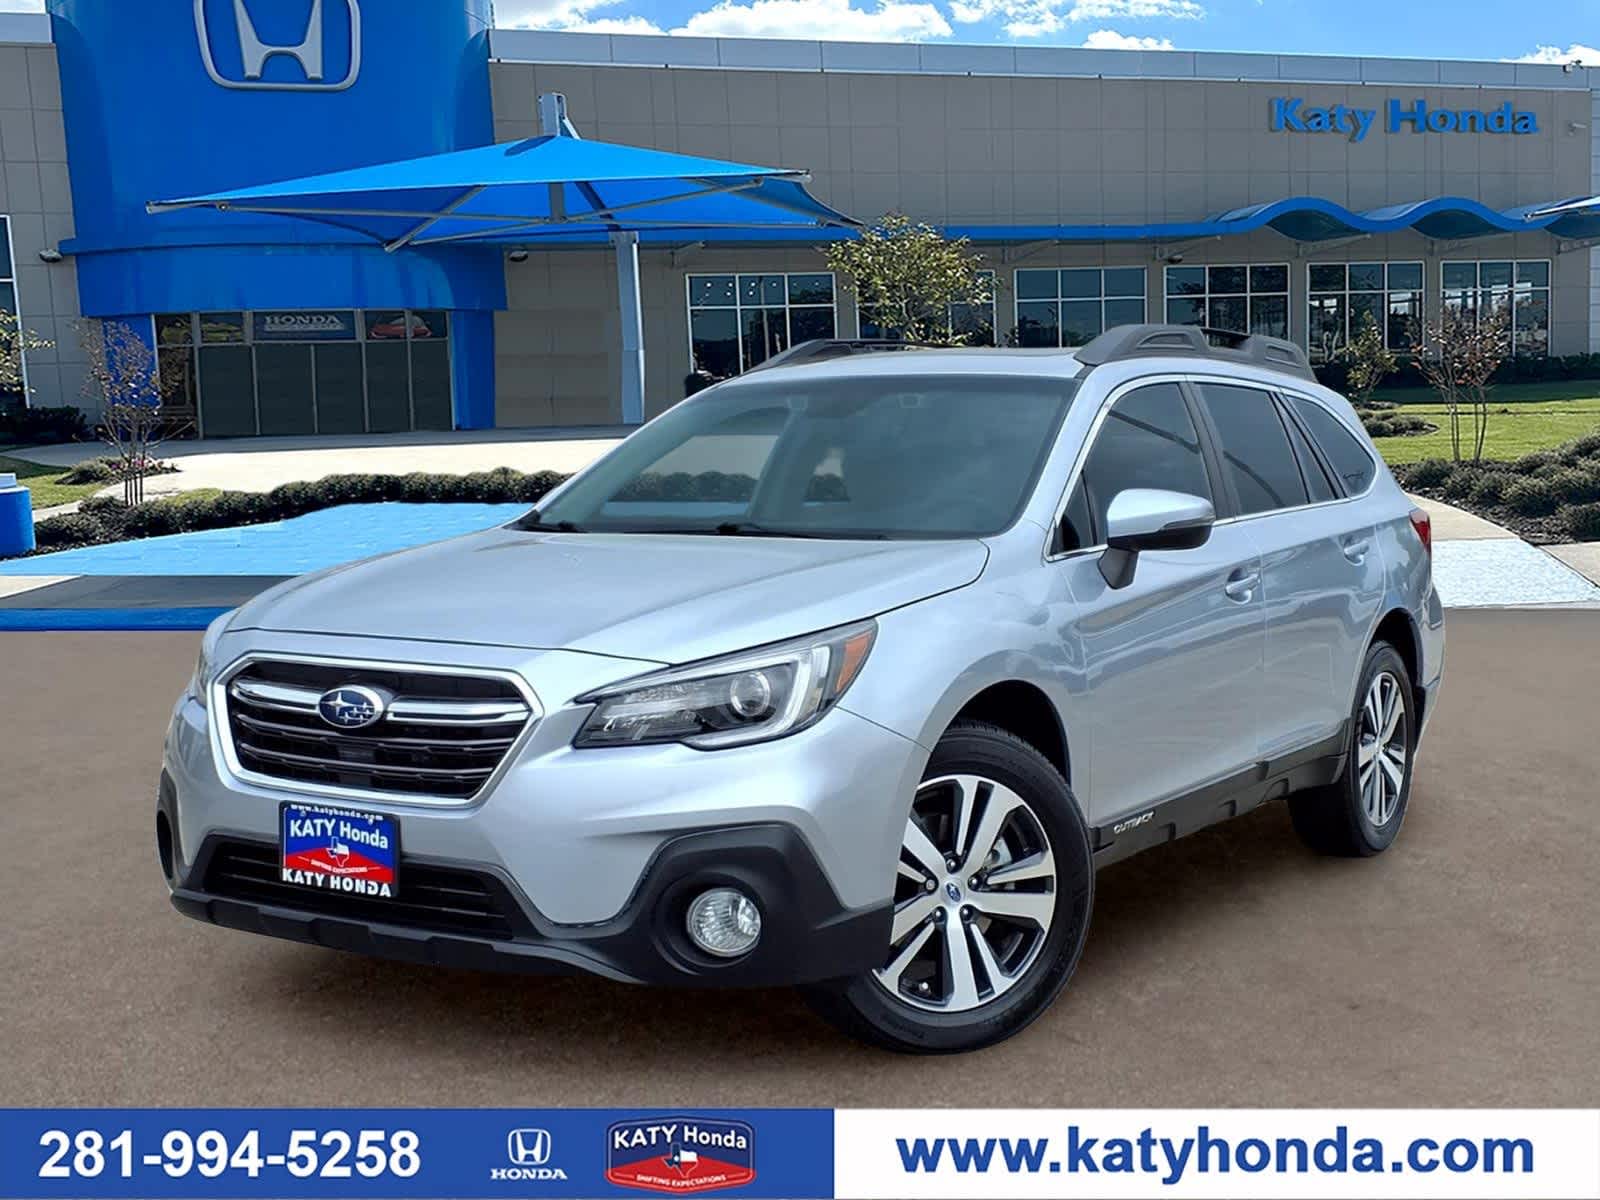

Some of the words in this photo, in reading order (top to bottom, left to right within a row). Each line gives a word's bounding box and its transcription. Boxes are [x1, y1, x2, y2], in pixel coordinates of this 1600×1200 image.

[1270, 97, 1376, 142] Katy
[1386, 98, 1539, 134] Honda
[265, 315, 342, 325] HONDA
[290, 818, 336, 837] KATY
[340, 820, 388, 849] Honda
[282, 868, 325, 887] KATY
[329, 875, 391, 897] HONDA
